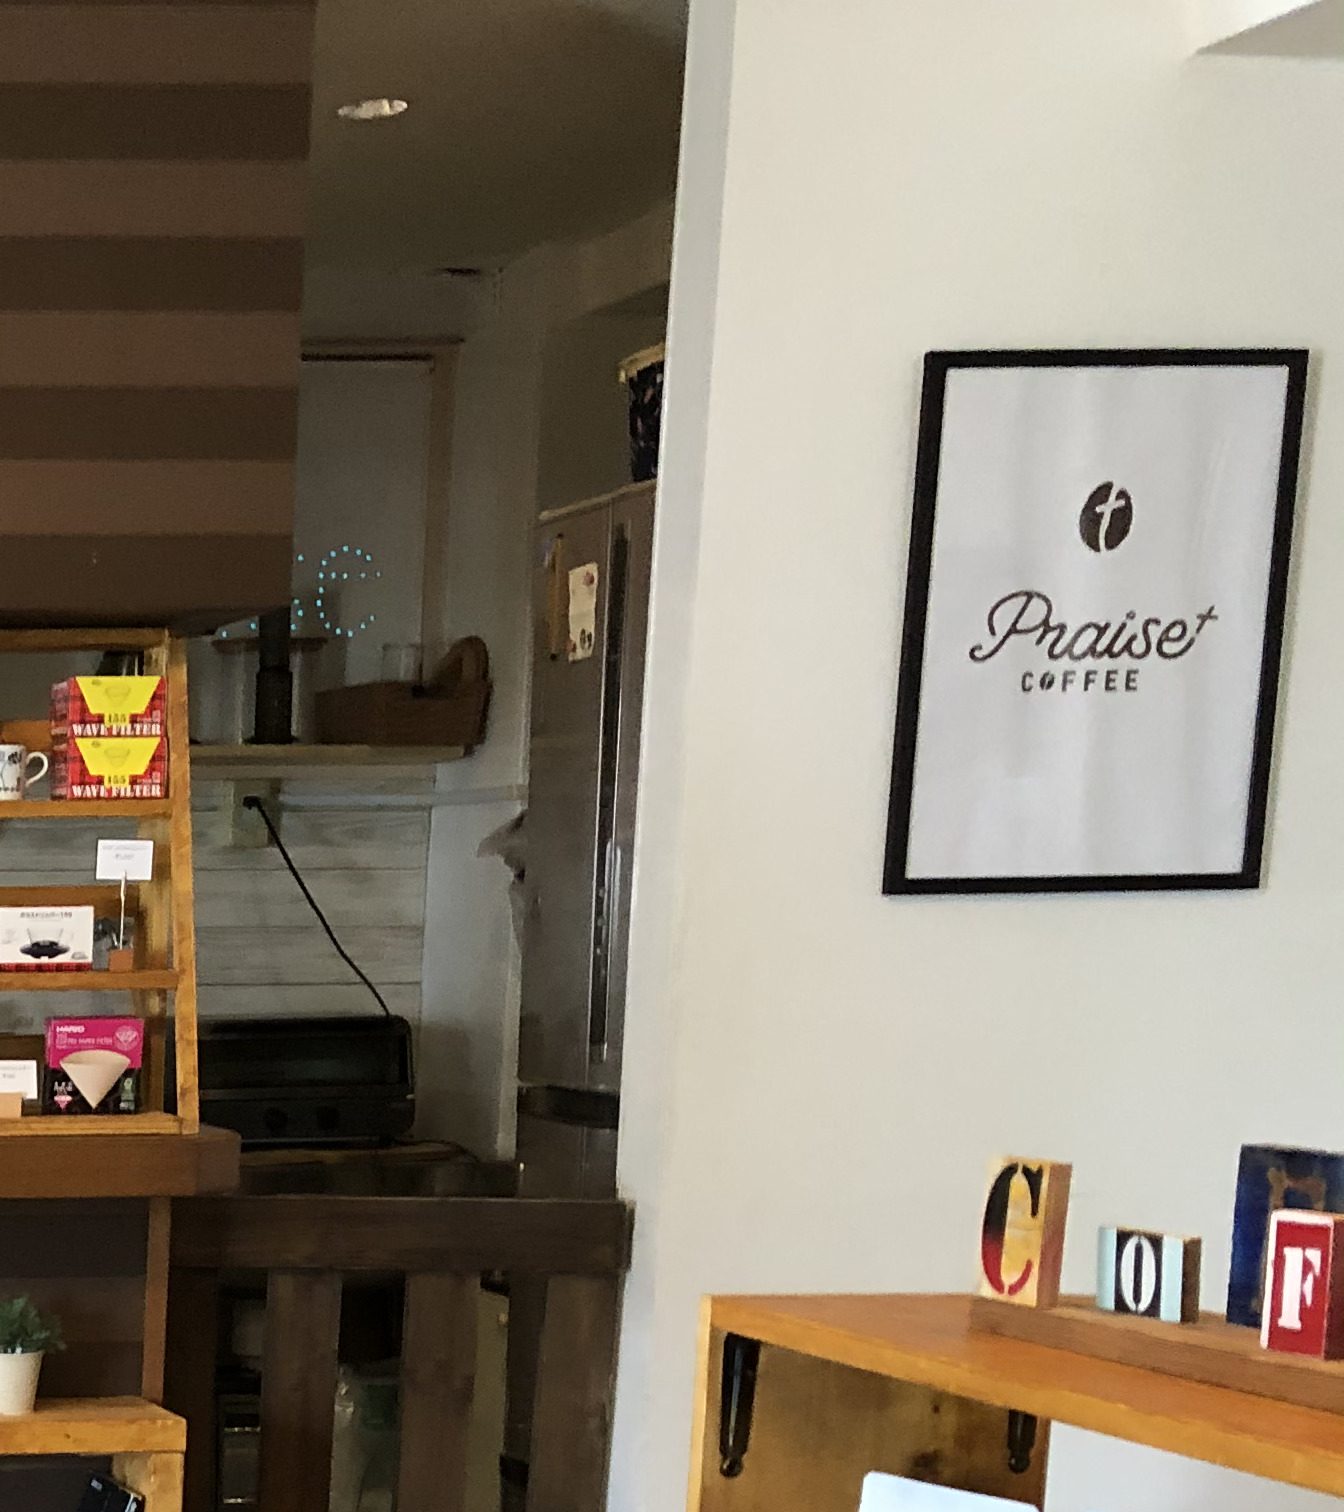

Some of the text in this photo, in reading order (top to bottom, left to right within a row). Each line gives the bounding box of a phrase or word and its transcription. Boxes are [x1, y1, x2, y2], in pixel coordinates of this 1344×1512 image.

[969, 589, 1198, 662] Praise
[1020, 669, 1140, 694] COFFEE
[111, 723, 161, 736] FILTER
[111, 784, 161, 798] FILTER
